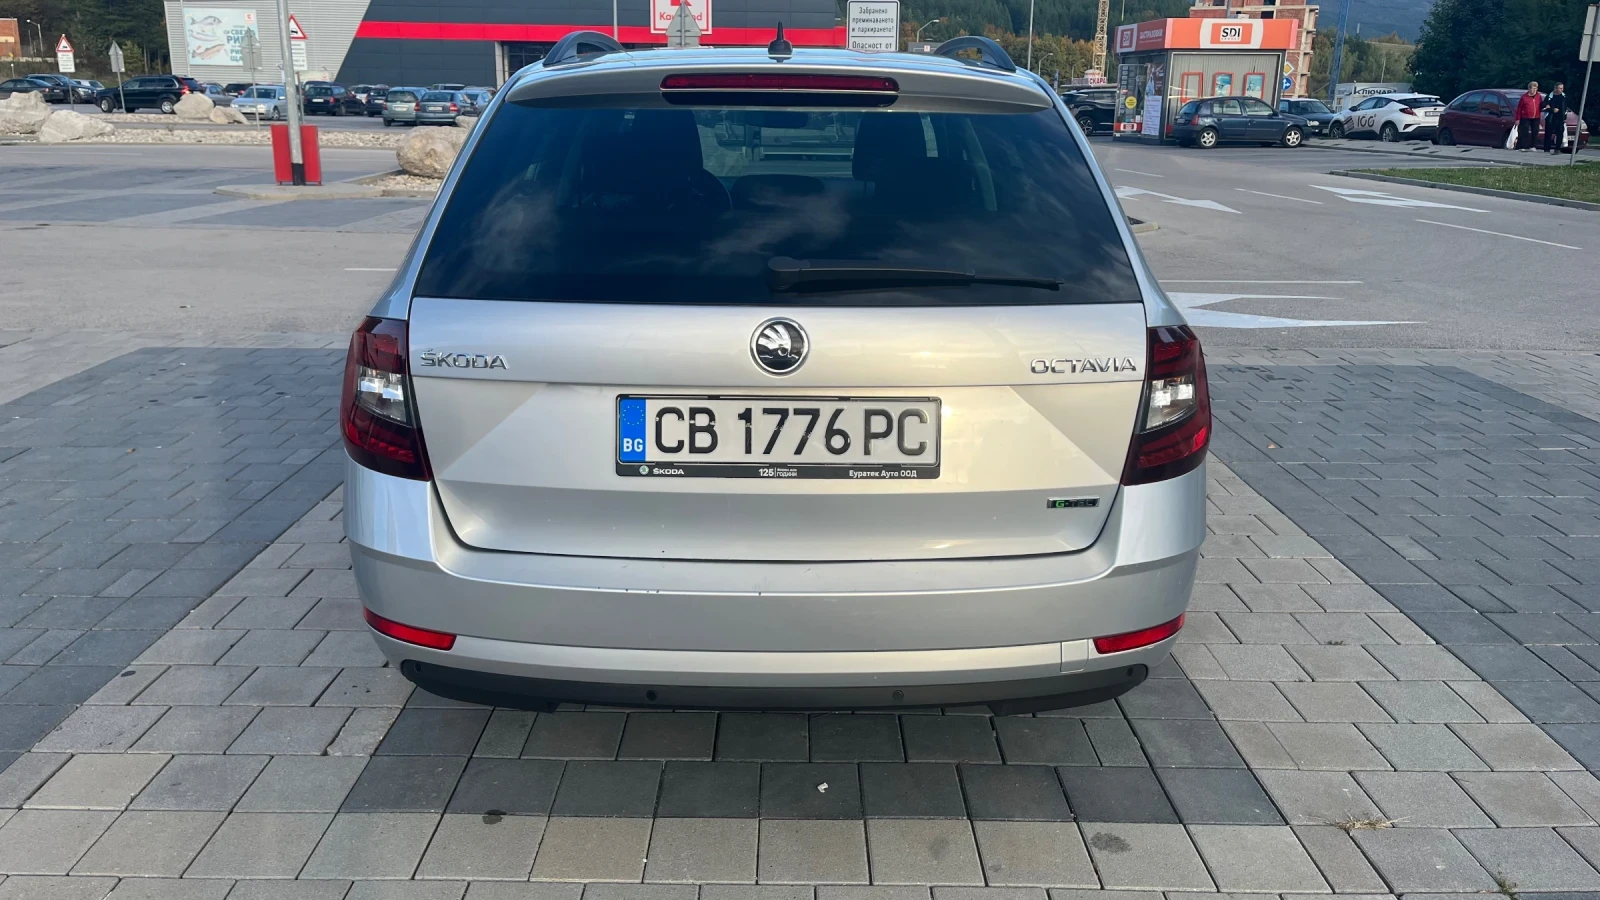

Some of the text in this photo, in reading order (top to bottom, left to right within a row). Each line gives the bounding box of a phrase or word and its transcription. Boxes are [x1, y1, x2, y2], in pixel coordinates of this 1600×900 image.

[859, 7, 888, 15] Забранено
[857, 26, 894, 34] паркирането!
[1221, 27, 1241, 38] SDI
[852, 41, 882, 50] Опасност
[420, 348, 510, 370] ŠKODA
[1031, 357, 1137, 373] OCTAVIA
[655, 406, 929, 456] CB 1776 PC
[623, 438, 643, 452] BG
[759, 468, 774, 477] 125
[881, 470, 898, 478] Ауто
